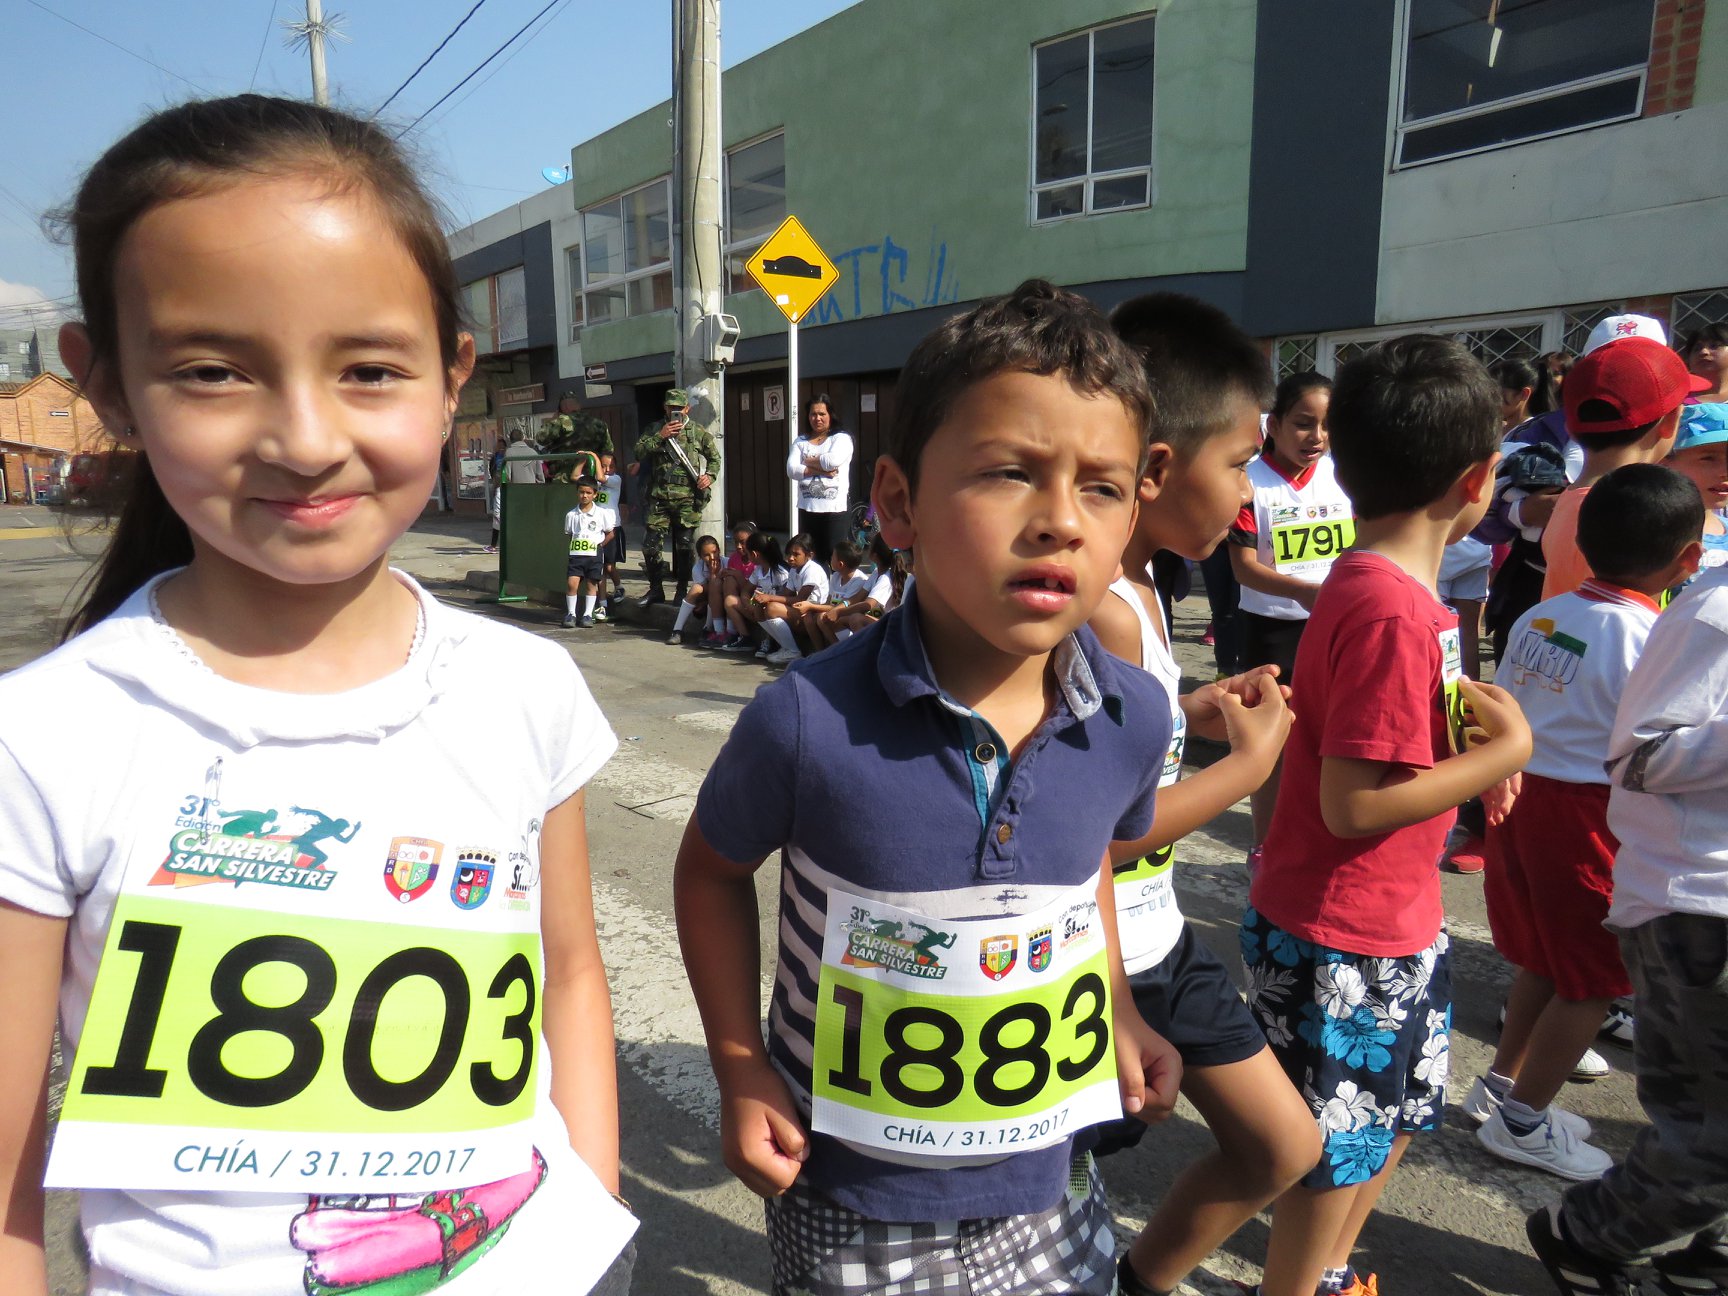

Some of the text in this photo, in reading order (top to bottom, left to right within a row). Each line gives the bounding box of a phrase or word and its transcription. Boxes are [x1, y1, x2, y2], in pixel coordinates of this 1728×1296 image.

[571, 540, 596, 551] 1884
[1278, 524, 1344, 560] 1791
[174, 816, 221, 832] Edición
[176, 832, 294, 865] CARRERA
[169, 852, 334, 888] SAN SILVESTRE
[850, 945, 946, 978] SAN SILVESTRE
[852, 931, 916, 962] CARRERA
[80, 919, 536, 1112] 1803
[828, 972, 1109, 1109] 1883
[883, 1108, 1069, 1149] CHÍA / 31.12.2017
[173, 1139, 477, 1178] CHÍA / 31.12.2017
